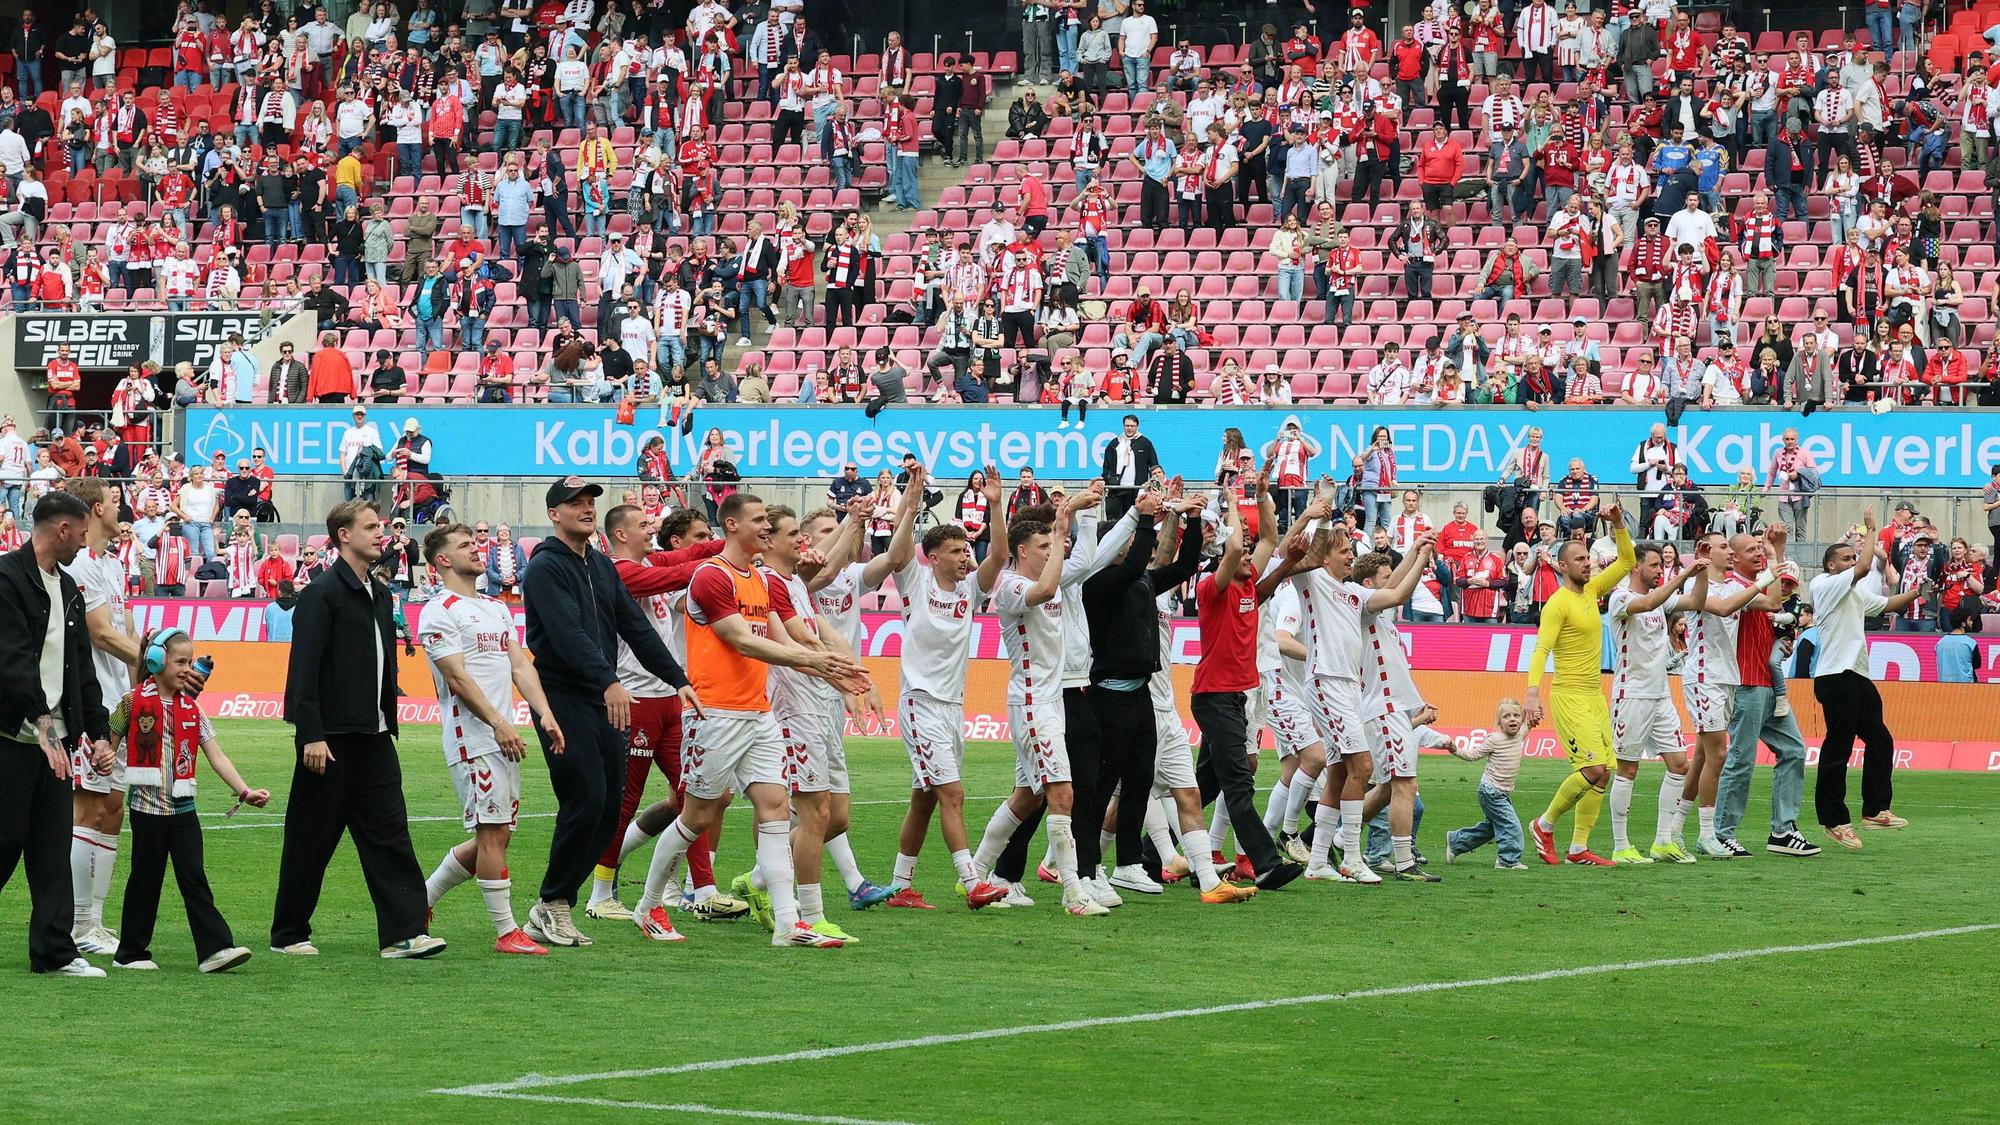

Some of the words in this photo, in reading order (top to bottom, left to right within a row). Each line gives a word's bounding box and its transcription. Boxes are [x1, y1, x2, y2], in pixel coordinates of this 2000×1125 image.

[24, 320, 128, 342] SILBER
[113, 343, 140, 351] ENERGY
[1330, 424, 1531, 472] NEDAX
[927, 599, 953, 611] REWE
[477, 633, 499, 643] REWE
[751, 623, 767, 637] EWE
[219, 695, 284, 717] DERTO
[396, 704, 441, 721] TOUR
[843, 718, 895, 737] TOUR
[964, 715, 1011, 740] DERT
[630, 748, 654, 757] REWE
